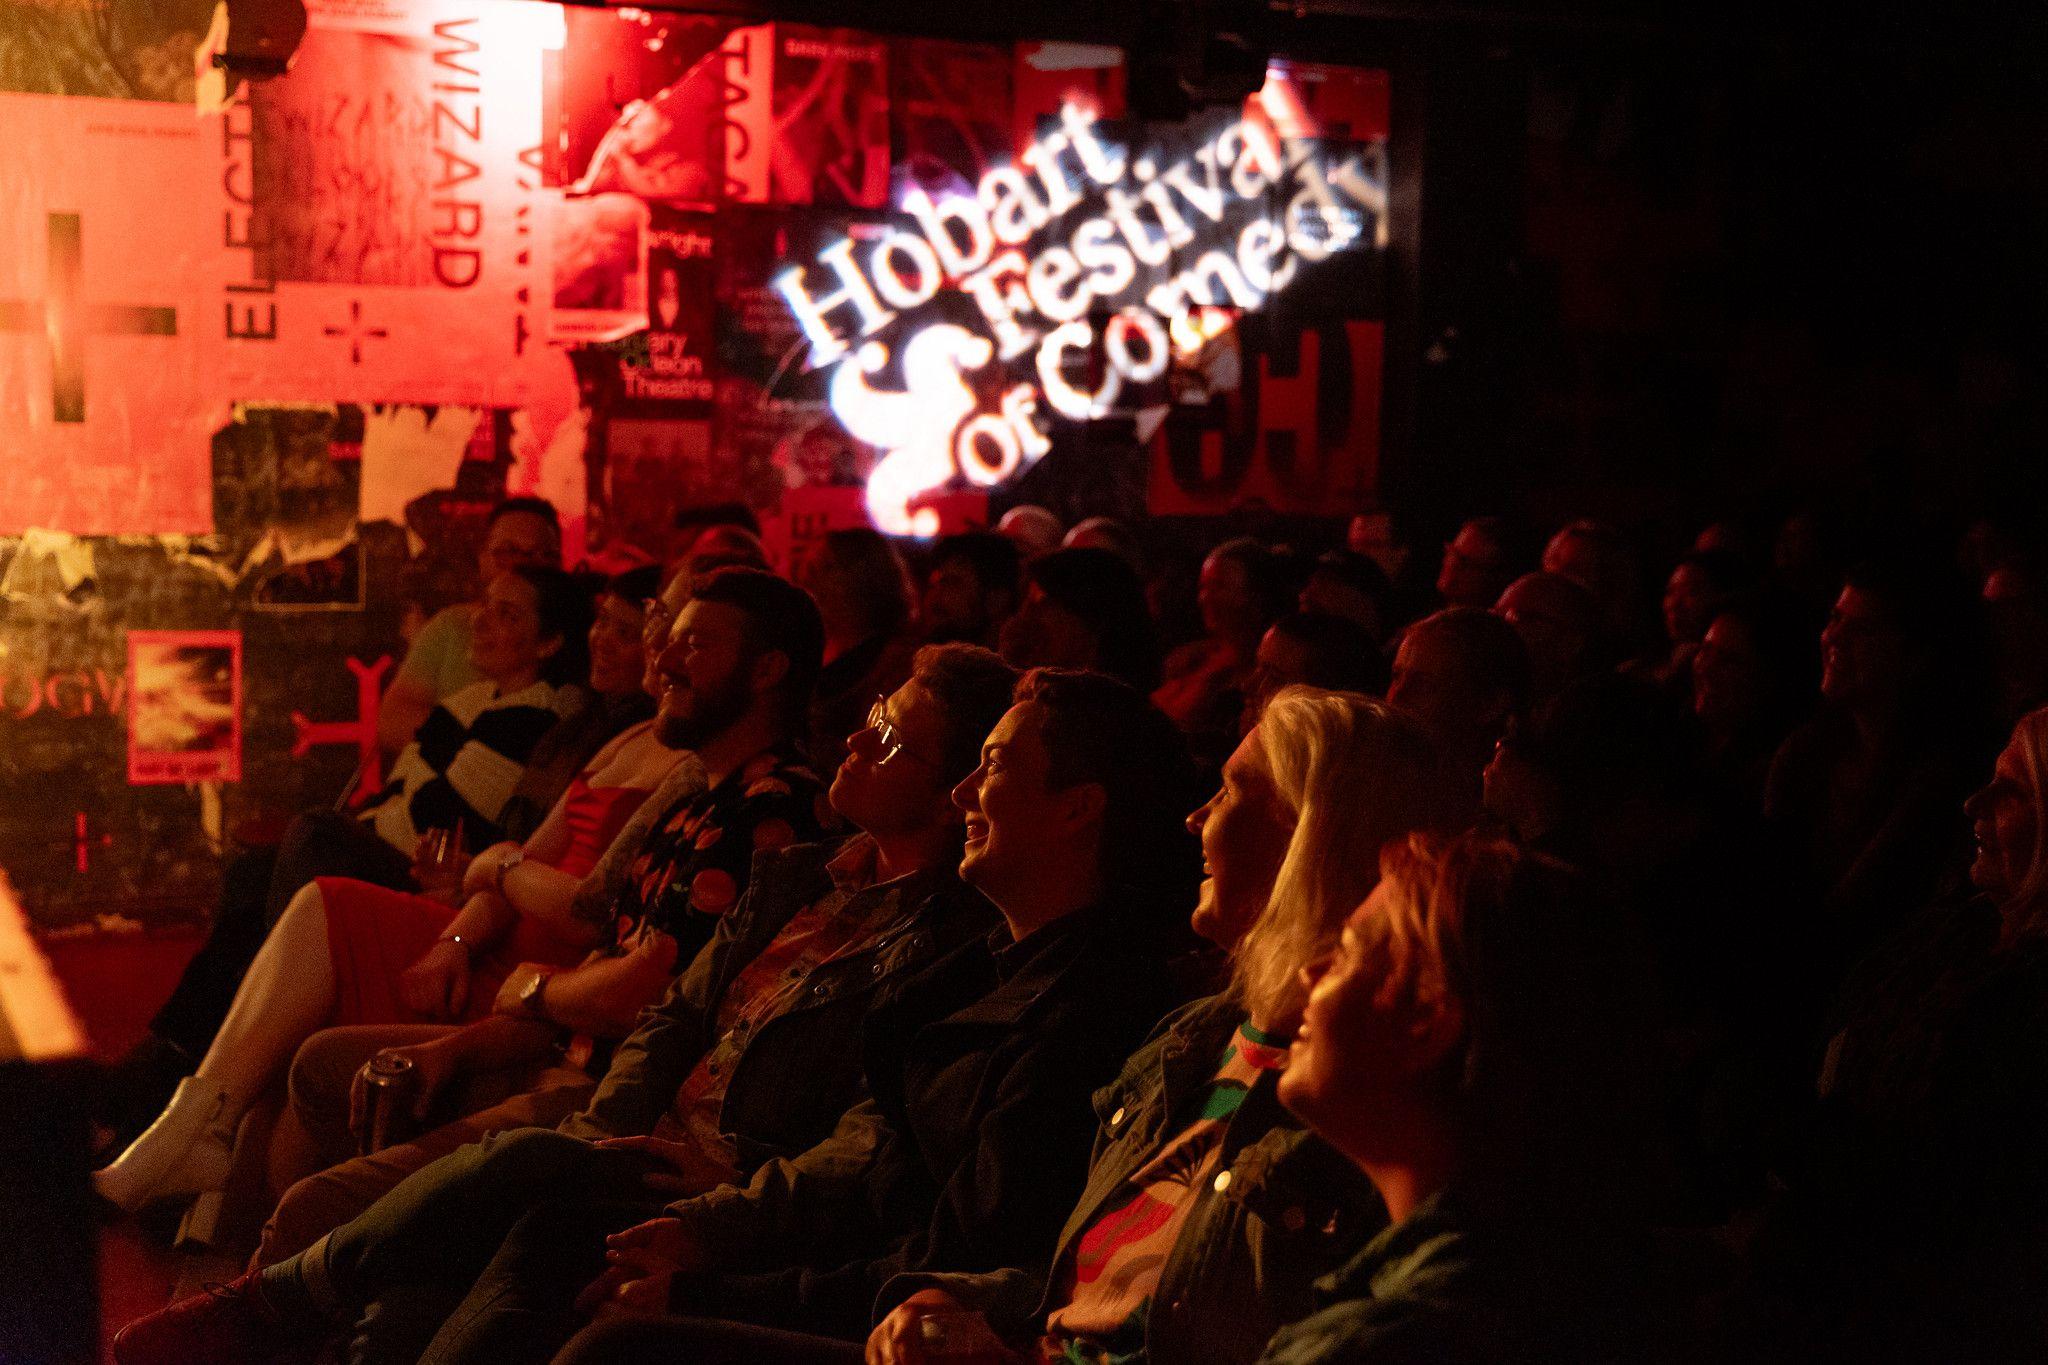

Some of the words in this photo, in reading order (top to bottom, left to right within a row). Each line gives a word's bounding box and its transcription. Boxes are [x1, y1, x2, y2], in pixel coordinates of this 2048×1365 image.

[432, 17, 482, 289] WIZARD
[770, 96, 1126, 372] Hobart
[960, 62, 1318, 362] Festival
[957, 384, 1052, 488] of
[1036, 135, 1390, 421] Comedy
